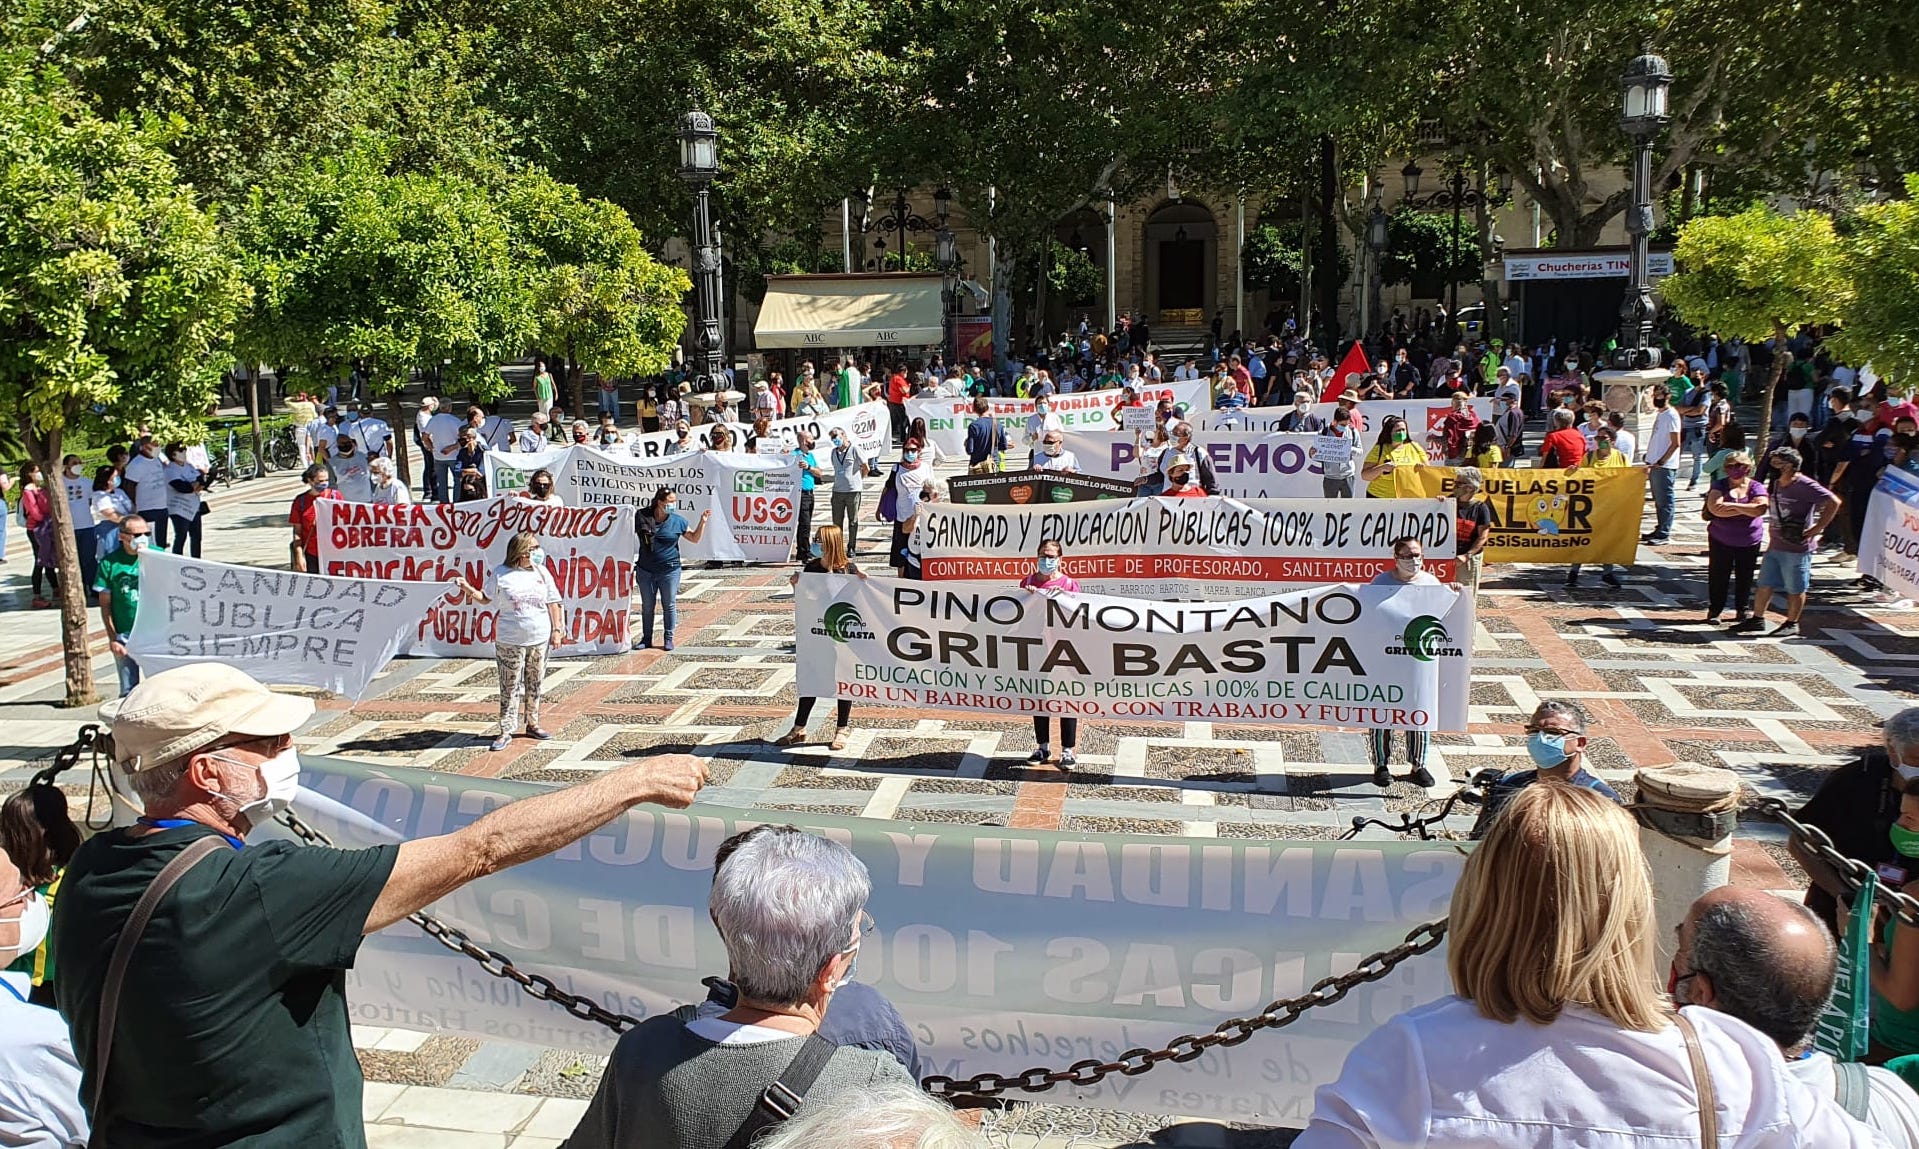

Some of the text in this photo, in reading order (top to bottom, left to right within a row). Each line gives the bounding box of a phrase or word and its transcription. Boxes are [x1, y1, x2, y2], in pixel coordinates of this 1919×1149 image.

[1537, 261, 1603, 272] Chucherias
[804, 333, 826, 342] ABC
[876, 331, 899, 340] ABC
[953, 403, 976, 414] PO
[994, 403, 1016, 414] LA
[1020, 395, 1101, 413] MYORÍA
[929, 418, 955, 430] EN
[1082, 410, 1104, 424] LO
[1110, 442, 1324, 475] PEMO
[576, 459, 705, 480] EN DEFENSA DE LOS
[706, 484, 716, 496] Y
[953, 480, 968, 488] LOS
[968, 477, 1007, 487] DERECHOS
[1018, 474, 1065, 485] GARANTIZAN
[1065, 476, 1089, 487] DESDE
[1090, 481, 1100, 489] LO
[1100, 481, 1133, 494] PÚBLICO
[1441, 479, 1595, 496] EUELAS DE
[583, 491, 696, 512] DERECHO LA
[732, 496, 793, 524] USO
[332, 502, 433, 527] MAREA
[431, 503, 481, 550] San
[926, 511, 1009, 549] SANIDAD
[1018, 511, 1033, 553] Y
[1041, 500, 1150, 550] EDUCACIÓN
[1157, 498, 1253, 547] PÚBLICAS
[1262, 511, 1314, 547] 100%
[1322, 511, 1351, 548] DE
[1360, 511, 1450, 548] CALIDAD
[331, 527, 425, 549] OBRERA
[733, 534, 790, 546] SEVILLA
[929, 557, 1038, 577] CONTRATACIÓN
[1060, 558, 1115, 576] RGENTE
[1125, 559, 1143, 574] DE
[1154, 558, 1271, 580] PROFESORADO,
[1282, 561, 1385, 578] SANITARIOS
[180, 565, 409, 608] SANIDAD
[1204, 585, 1232, 595] MAREA
[168, 591, 366, 634] PÚBLICA
[893, 587, 1362, 634] PINO MONTANO
[811, 627, 876, 640] GRITA BASTA
[168, 632, 358, 668] SIEMPRE
[886, 625, 1368, 677] GRITA BASTA
[1385, 646, 1463, 657] GRITA BASTA
[854, 663, 1404, 703] EDUCACIÓN Y SANIDAD PÚBLICAS 100% DE CALIDAD
[837, 680, 1430, 727] POR UN BARRIO DIGNO, CON TRABAJO Y FUTURO
